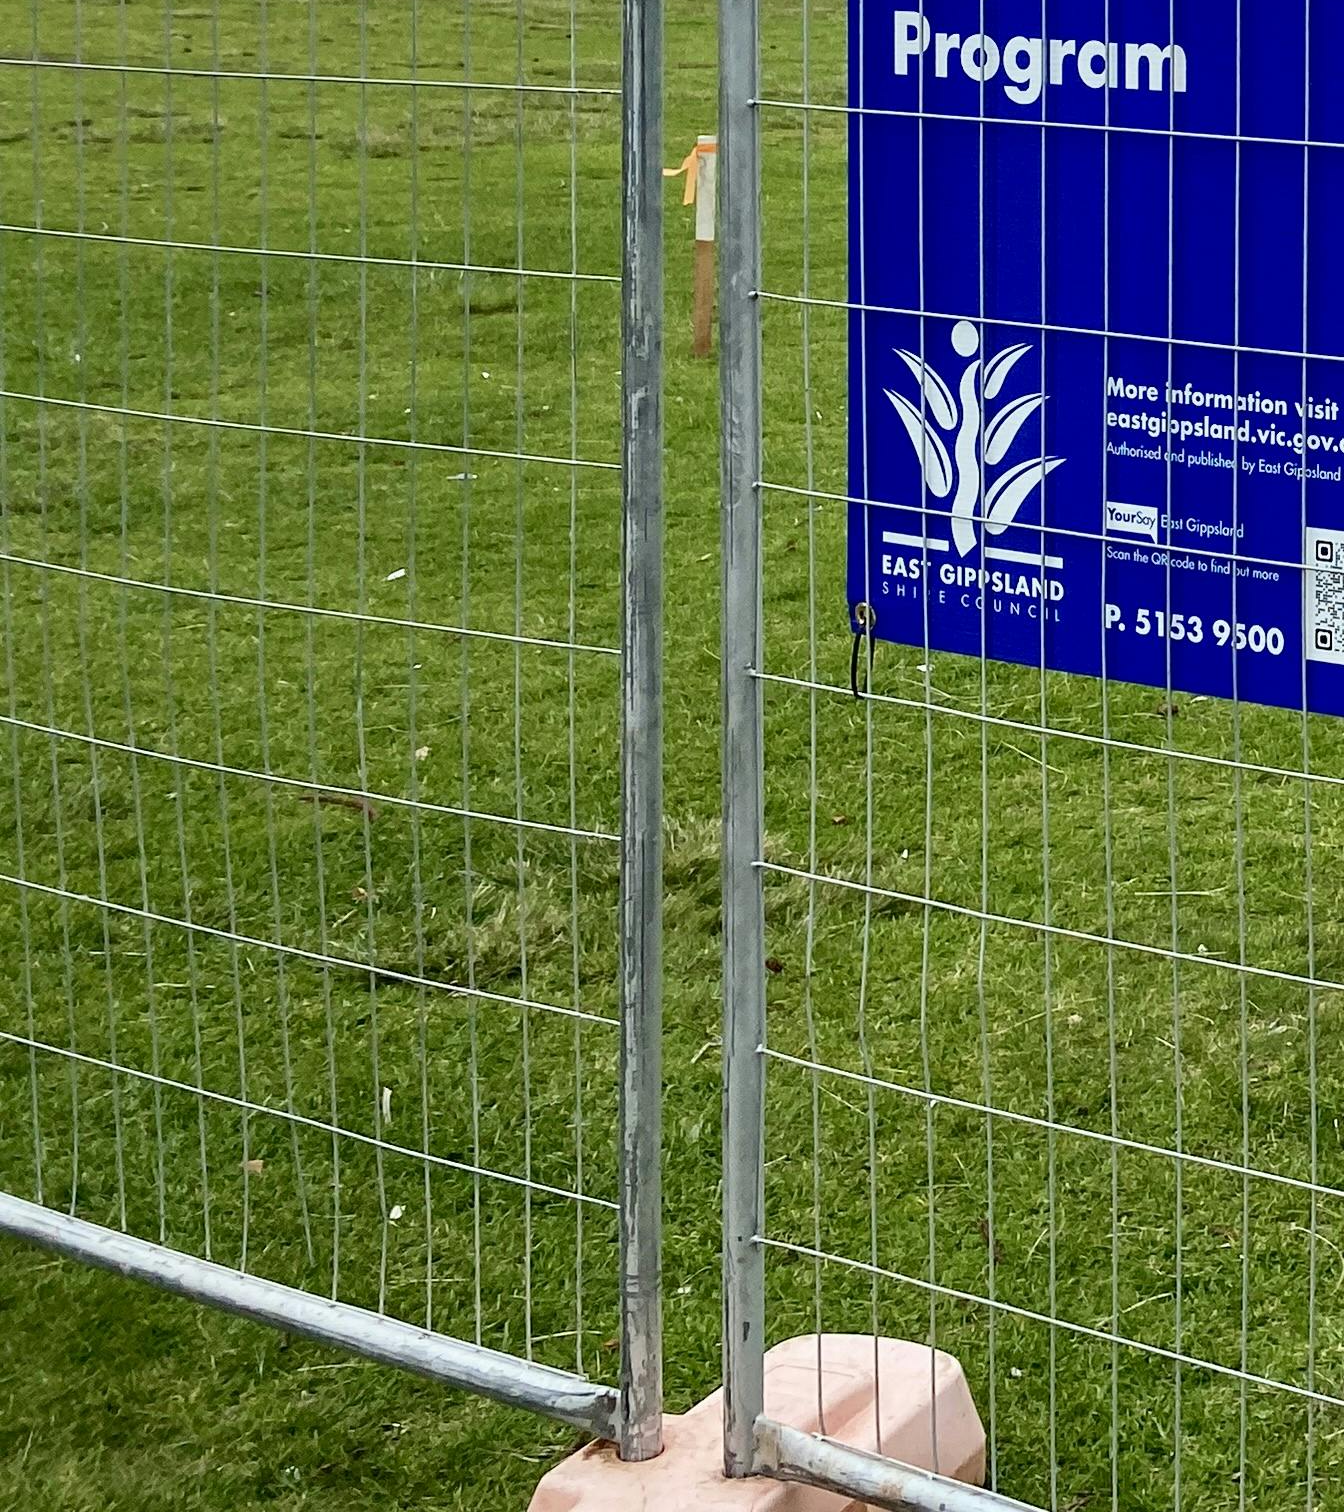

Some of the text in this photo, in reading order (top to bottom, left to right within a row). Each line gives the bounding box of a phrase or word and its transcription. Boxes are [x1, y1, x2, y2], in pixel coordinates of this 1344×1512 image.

[894, 10, 1187, 104] Program
[1107, 376, 1339, 421] More information visit
[1107, 442, 1161, 461] Authorised
[1241, 456, 1255, 475] by
[1259, 459, 1281, 474] East
[1107, 508, 1244, 539] YourSay East Gippsland
[940, 563, 1064, 601] GIPPSLAND
[1106, 545, 1131, 561] Scan
[1133, 549, 1149, 564] the
[1151, 552, 1168, 567] QR
[1170, 554, 1195, 570] code
[1198, 559, 1208, 572] to
[1210, 559, 1231, 575] find
[1252, 569, 1279, 582] more
[882, 581, 1060, 622] SHIE COUNCIL
[1105, 603, 1284, 656] P. 5153 9500
